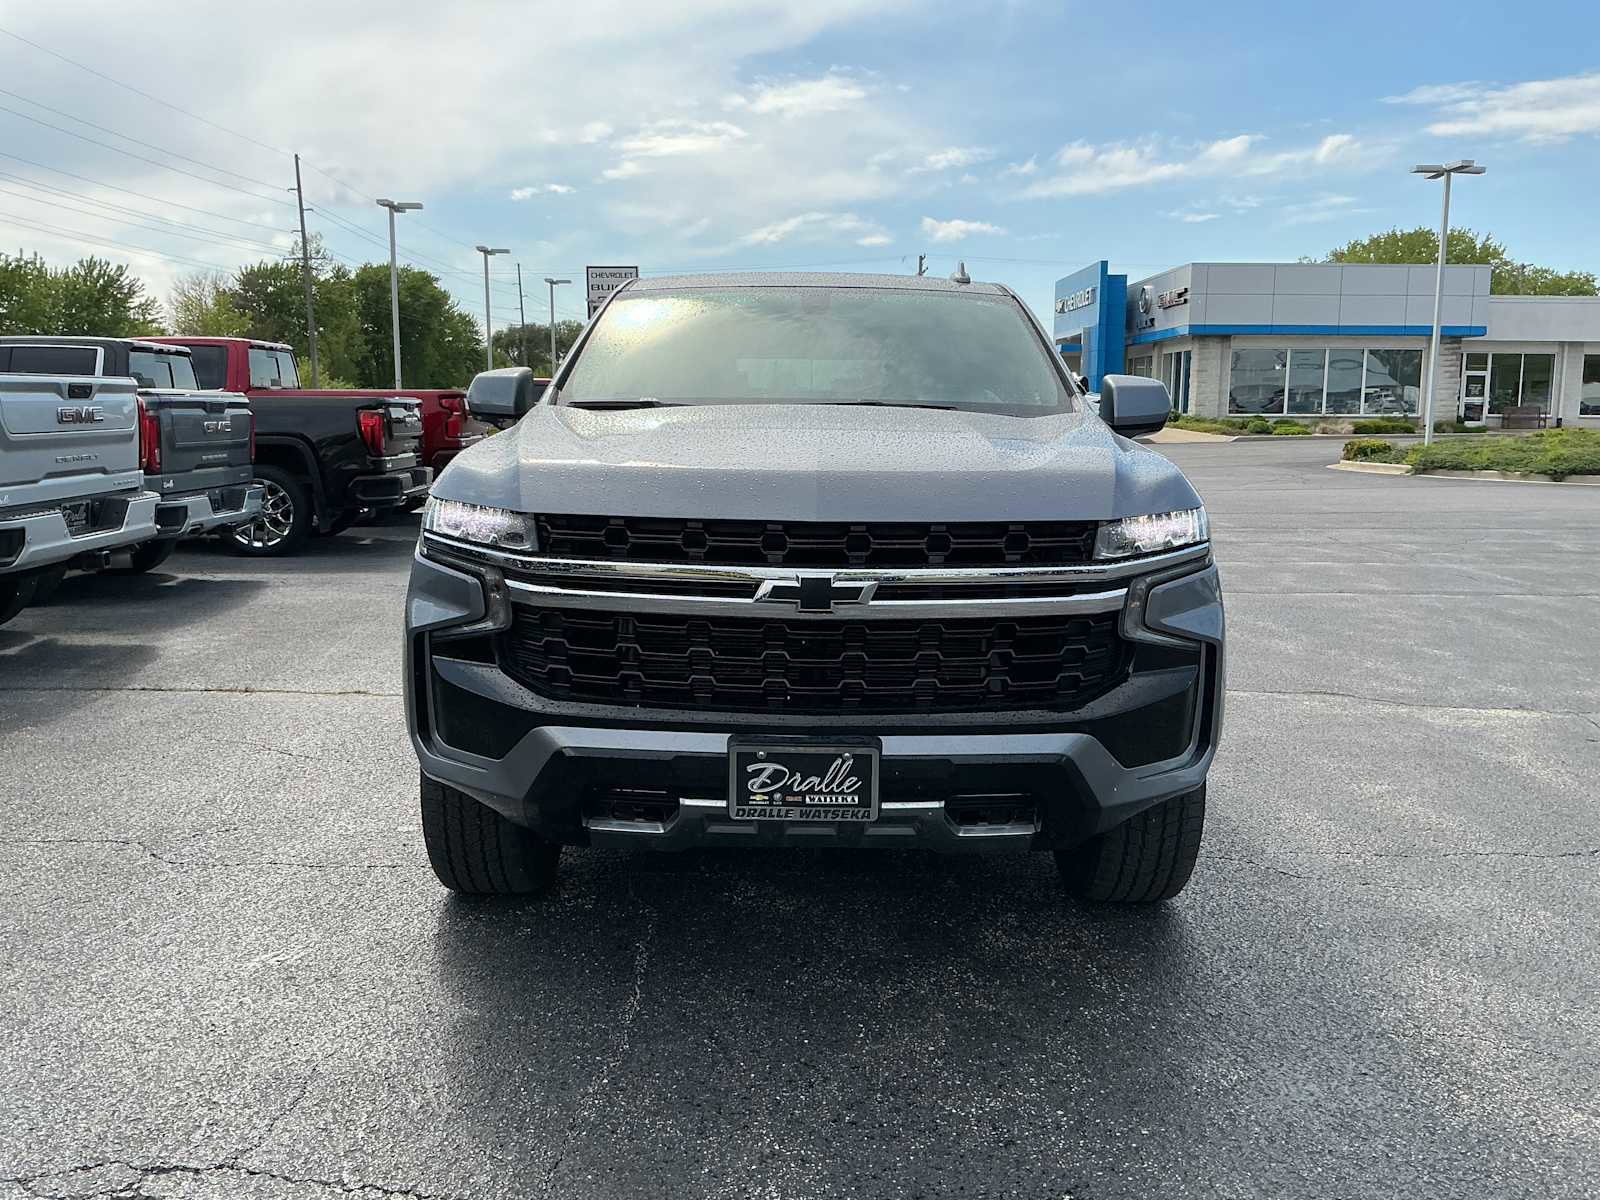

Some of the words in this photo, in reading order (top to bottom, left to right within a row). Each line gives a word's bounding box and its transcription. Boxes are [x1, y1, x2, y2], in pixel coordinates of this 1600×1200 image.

[57, 406, 104, 424] GMC
[746, 757, 863, 793] Dralle
[806, 795, 858, 804] WATSEKA
[735, 807, 795, 818] DRALLE
[800, 808, 871, 819] WATSEKA
